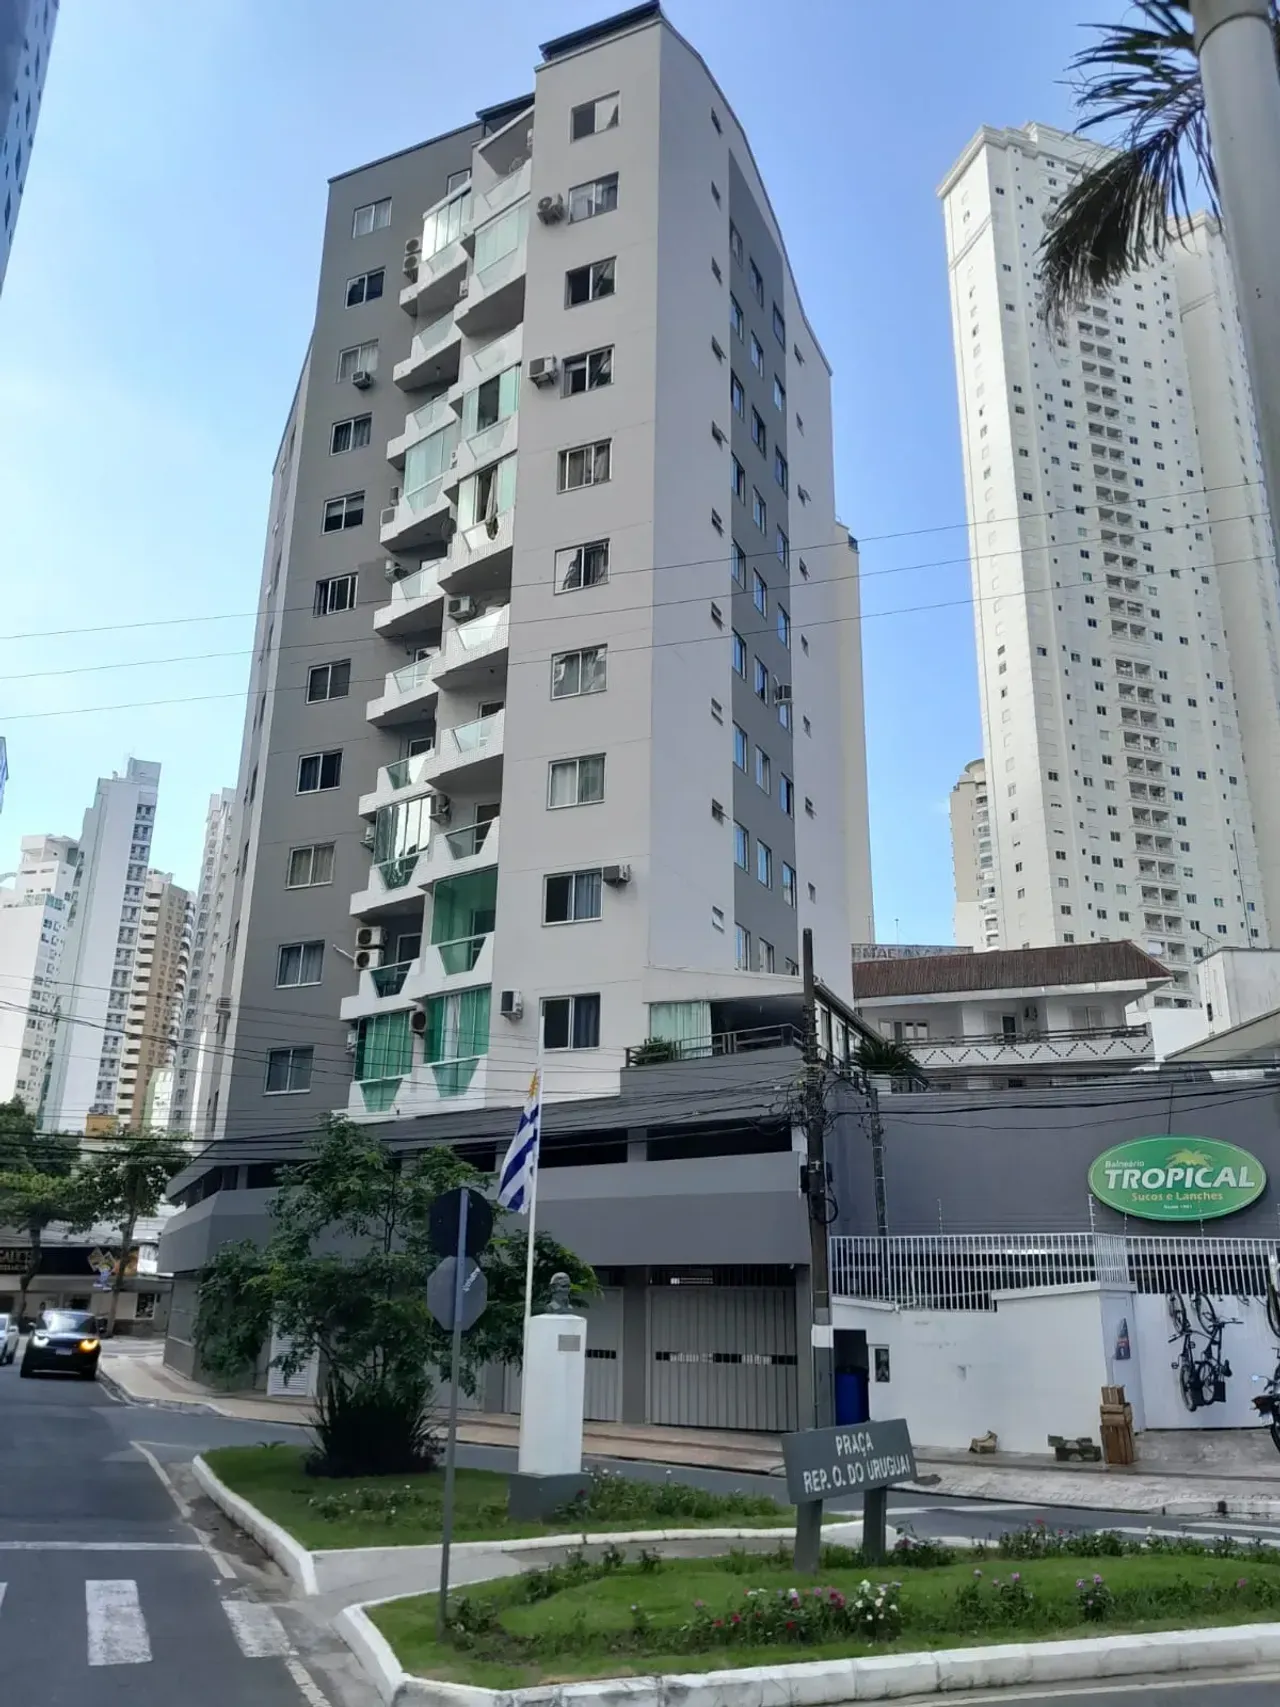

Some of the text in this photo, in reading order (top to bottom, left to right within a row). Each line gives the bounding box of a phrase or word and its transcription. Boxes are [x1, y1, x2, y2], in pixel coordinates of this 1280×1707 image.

[1105, 1166, 1255, 1189] TROPICAL
[1131, 1192, 1163, 1201] Sucos
[1176, 1191, 1223, 1201] Lanches
[835, 1431, 874, 1457] PRAÇA
[803, 1468, 831, 1494] REP.
[847, 1461, 864, 1485] DO
[866, 1454, 910, 1480] URUGUAI
